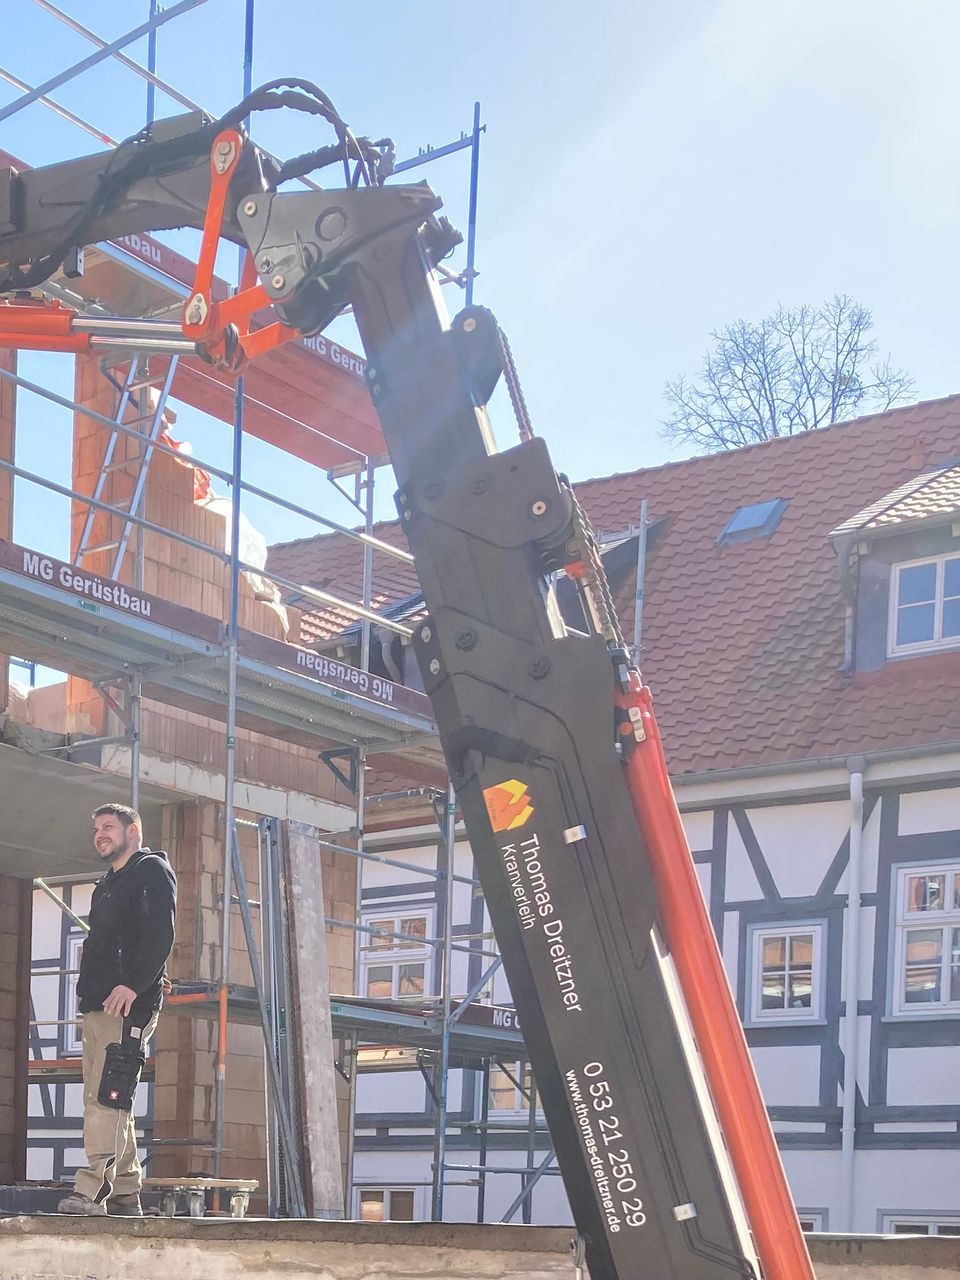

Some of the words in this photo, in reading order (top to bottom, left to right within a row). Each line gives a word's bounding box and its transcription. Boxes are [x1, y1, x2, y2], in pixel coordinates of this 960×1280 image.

[23, 551, 54, 580] MG
[59, 566, 151, 616] Gerüstbau
[372, 680, 393, 702] MG
[501, 843, 537, 930] Kranverleih
[520, 833, 554, 917] Thomas
[543, 919, 582, 1013] Dreitzner
[493, 1010, 512, 1027] MG
[583, 1061, 603, 1077] 0
[590, 1081, 613, 1111] 53
[598, 1115, 623, 1146] 21
[565, 1069, 621, 1233] www.thomas-dreitzner.de
[608, 1149, 637, 1193] 250
[621, 1197, 646, 1227] 29
